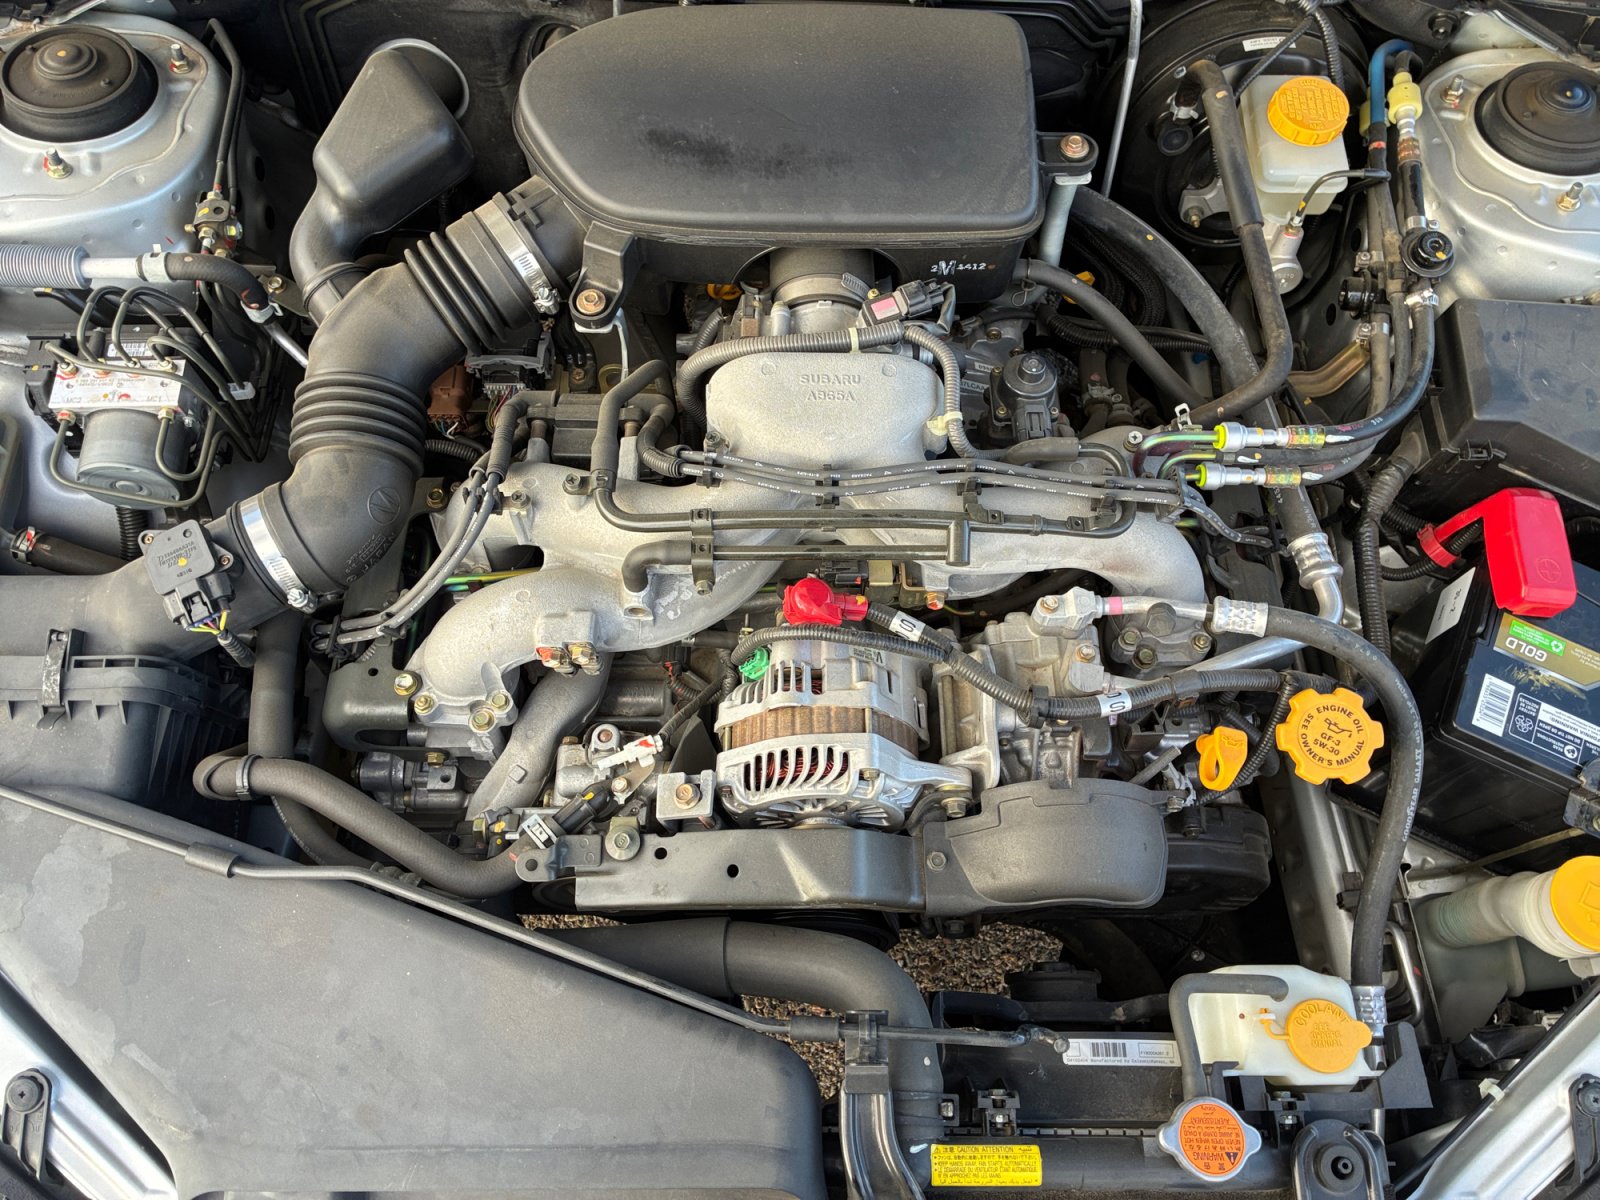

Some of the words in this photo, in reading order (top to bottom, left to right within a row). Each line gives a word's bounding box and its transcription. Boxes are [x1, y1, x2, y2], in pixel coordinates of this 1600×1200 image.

[799, 373, 861, 385] SUBARU
[1506, 637, 1548, 662] GOLD
[1301, 713, 1314, 731] SEE
[1316, 704, 1354, 719] ENGINE
[1353, 718, 1365, 734] OIL
[1300, 732, 1333, 767] OWNER'S
[1313, 738, 1340, 756] 5W-30
[1320, 732, 1342, 747] GF-3
[1336, 739, 1365, 767] MANUAL
[1401, 786, 1418, 842] GOODYEAR
[1414, 748, 1422, 783] GALAXY
[1294, 1002, 1352, 1026] COOLANT
[1193, 1152, 1224, 1161] WARNING
